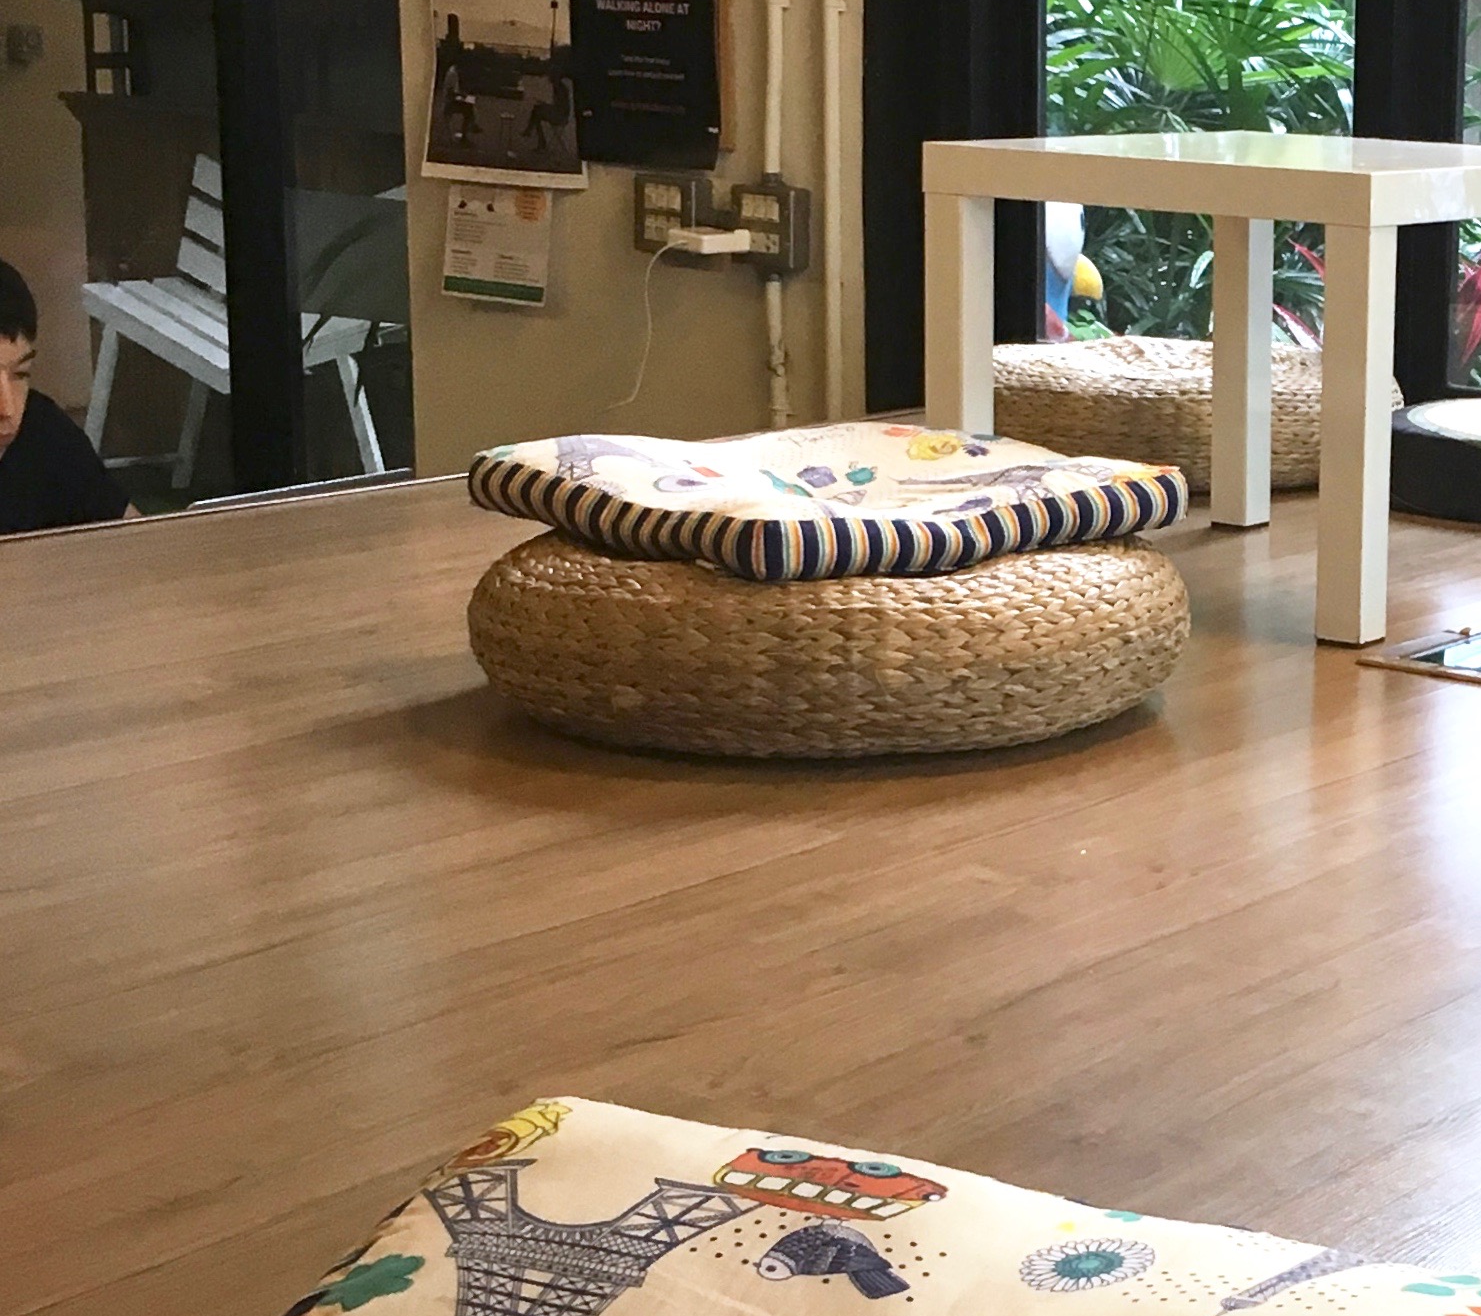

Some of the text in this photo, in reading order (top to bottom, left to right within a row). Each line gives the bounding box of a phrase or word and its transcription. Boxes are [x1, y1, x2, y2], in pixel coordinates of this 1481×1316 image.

[596, 0, 690, 15] WALKING ALONE AT
[626, 19, 662, 31] NIGHT?
